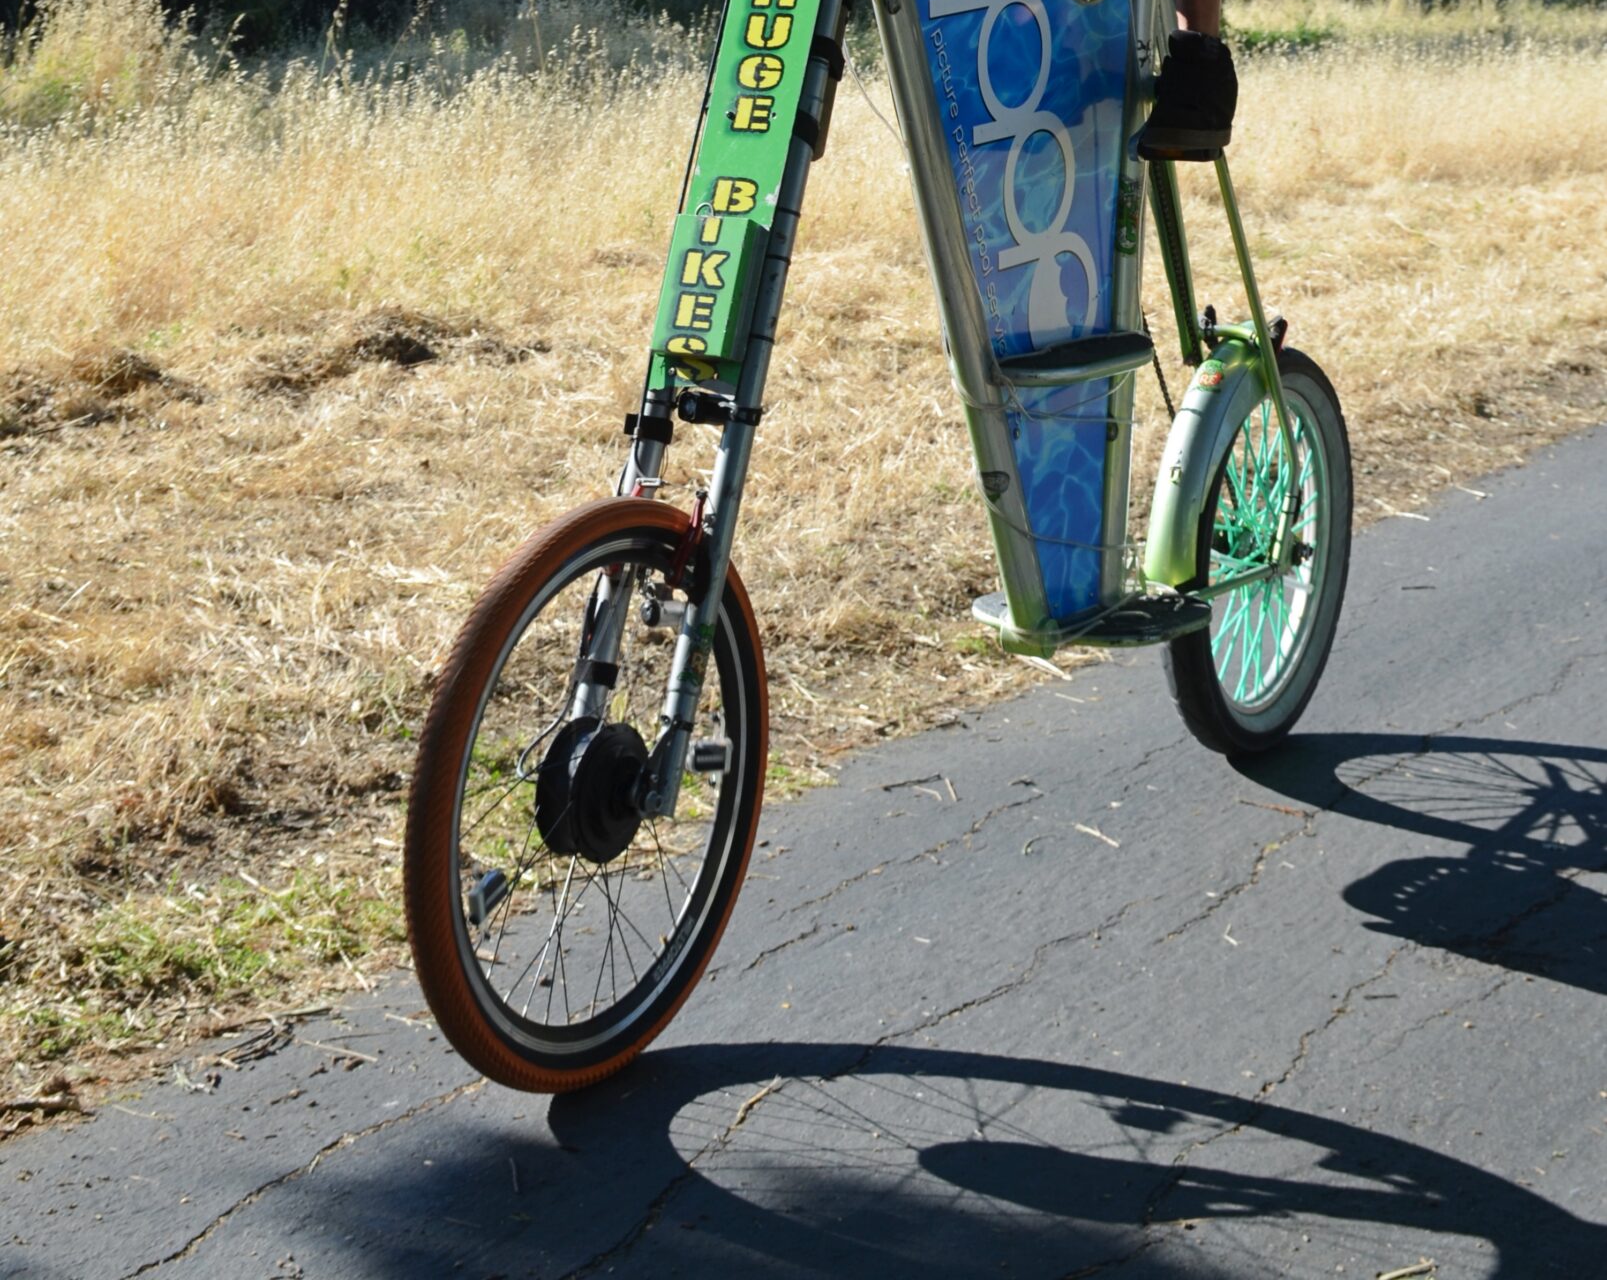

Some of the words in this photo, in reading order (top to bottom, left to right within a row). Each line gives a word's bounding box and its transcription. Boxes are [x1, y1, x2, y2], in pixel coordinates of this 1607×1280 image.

[930, 27, 959, 120] picture
[952, 123, 982, 217] perfect
[973, 224, 995, 278] pool
[666, 177, 759, 381] BIKES
